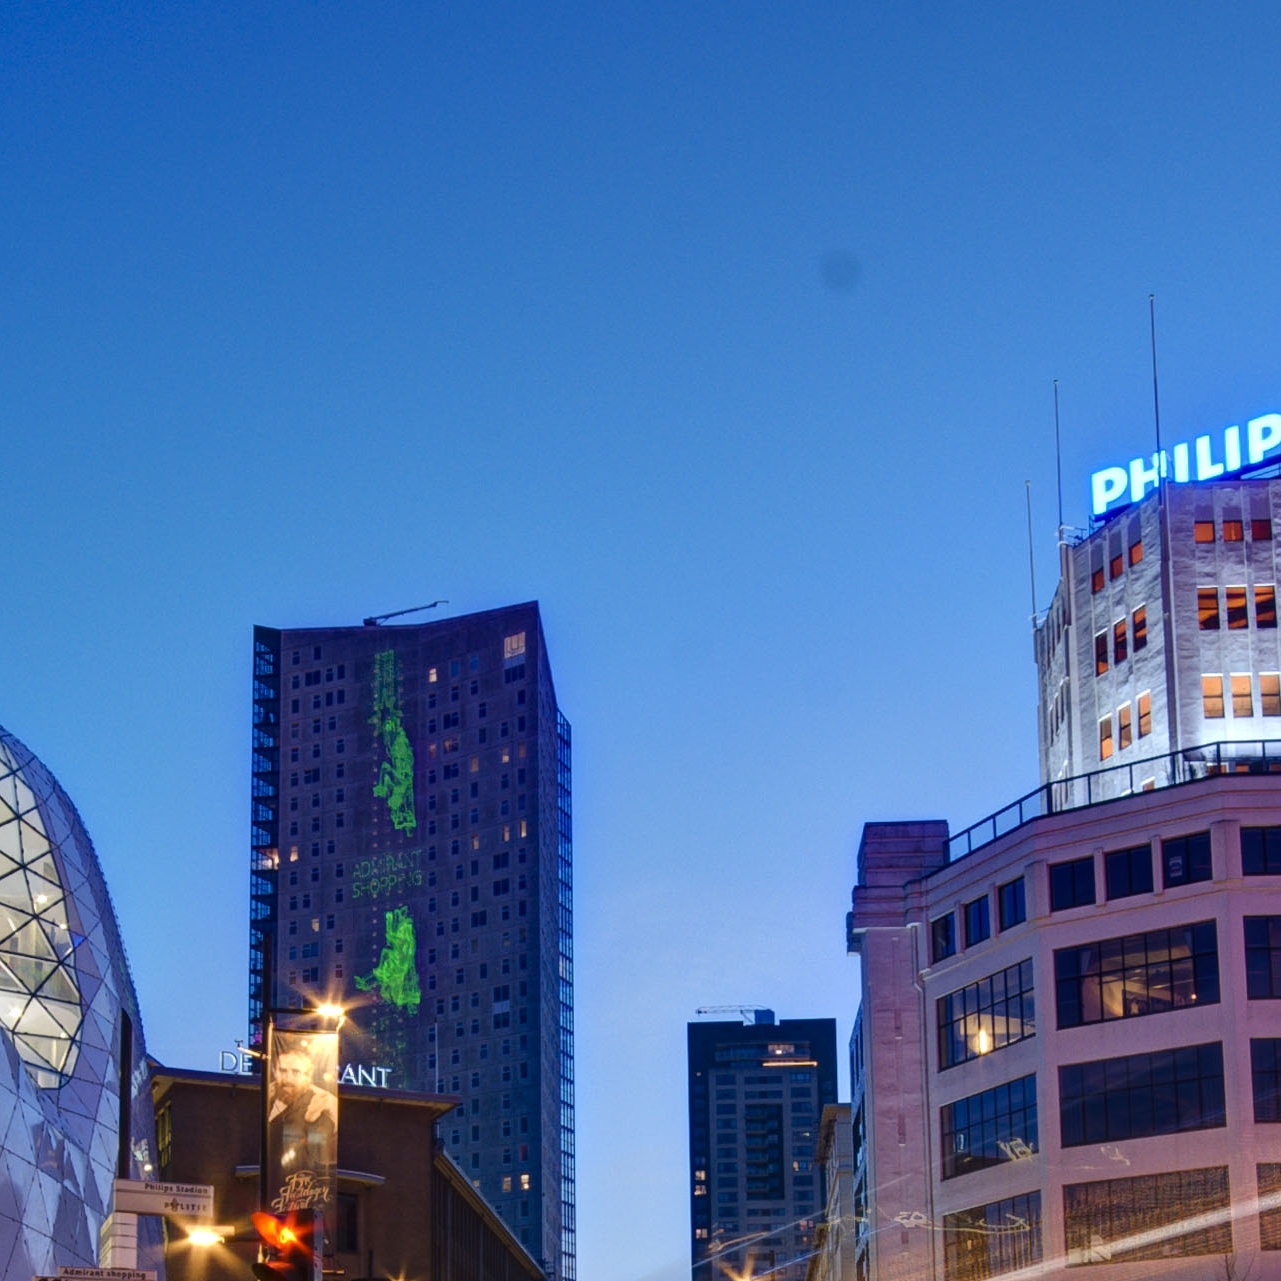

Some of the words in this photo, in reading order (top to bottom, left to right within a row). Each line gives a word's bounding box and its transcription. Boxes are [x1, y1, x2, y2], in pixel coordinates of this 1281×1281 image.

[338, 1063, 392, 1089] ANT
[144, 1182, 174, 1193] Philips
[176, 1184, 208, 1194] Stadion
[63, 1267, 104, 1277] Admirant
[106, 1269, 146, 1280] shopping
